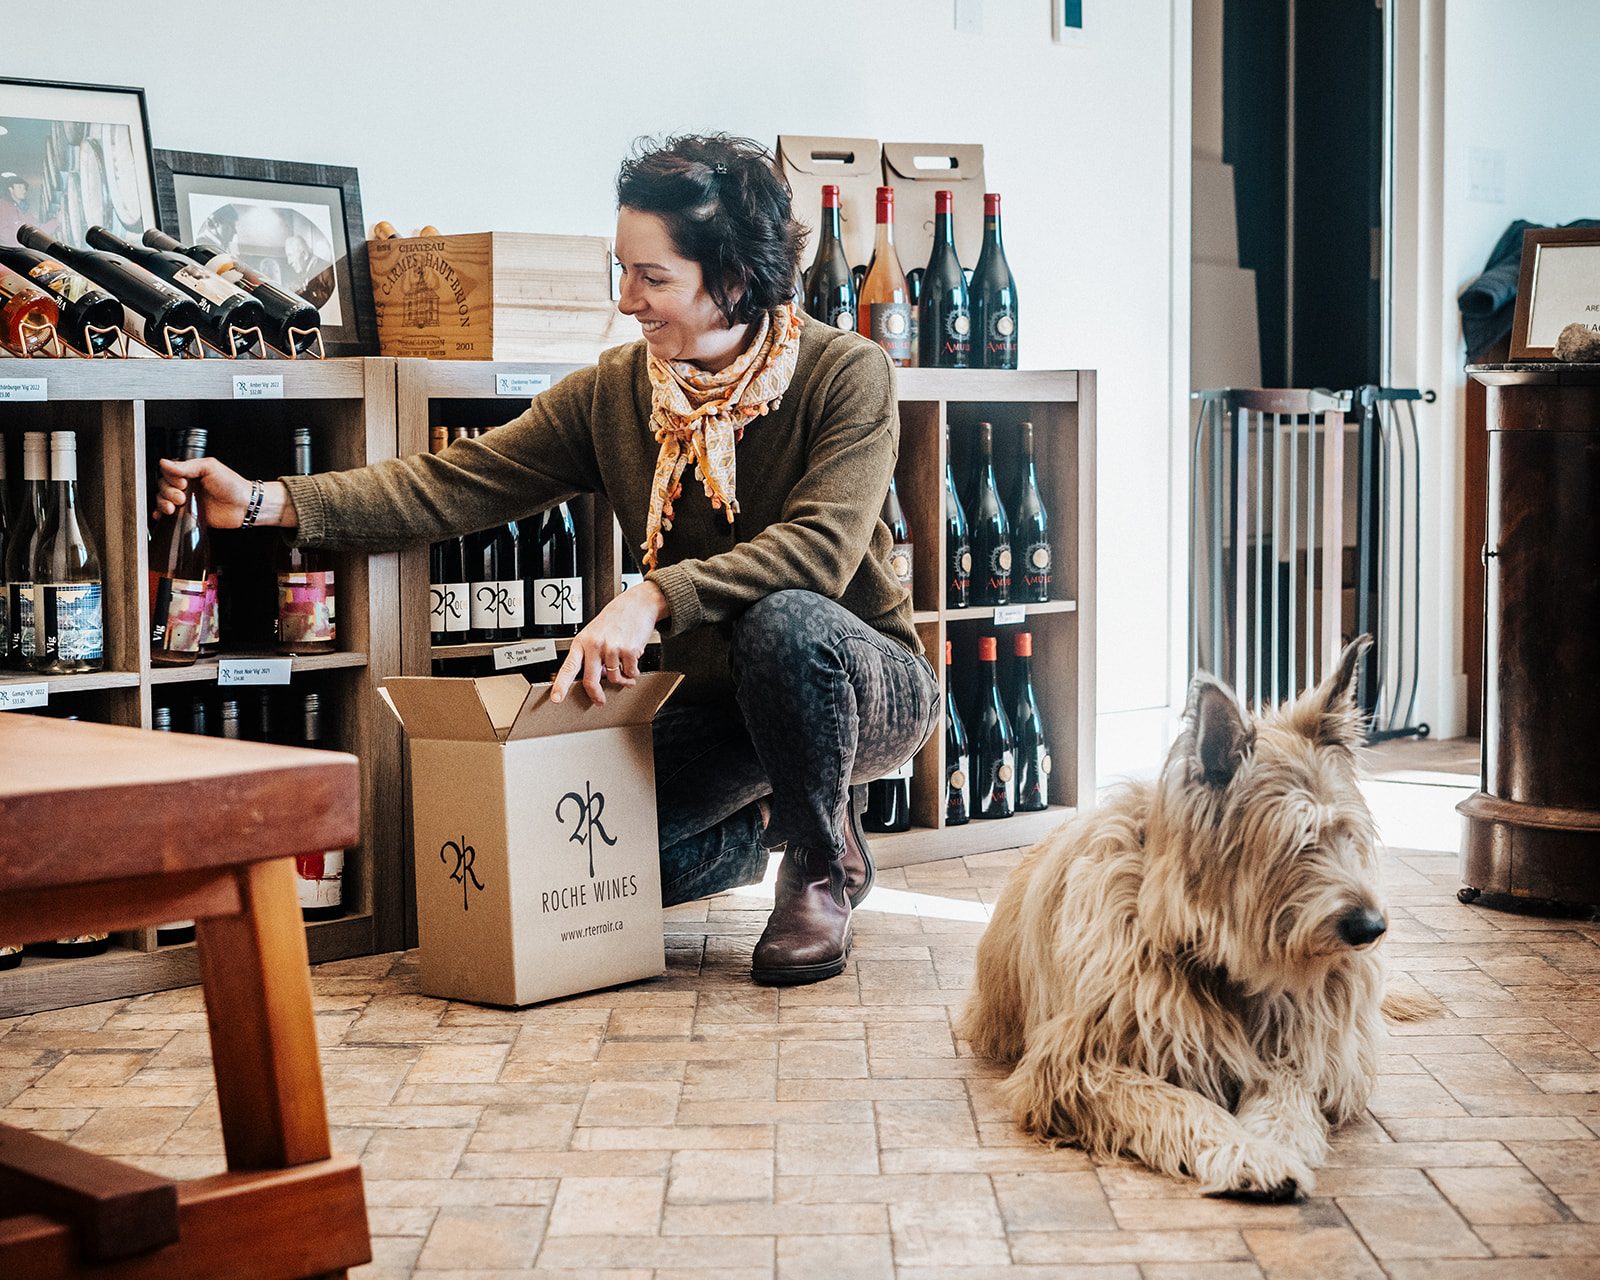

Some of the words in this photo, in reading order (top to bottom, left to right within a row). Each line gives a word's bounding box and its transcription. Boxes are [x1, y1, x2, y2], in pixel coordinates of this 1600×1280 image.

[399, 243, 445, 253] CHATEAU
[381, 253, 418, 296] CARMES
[424, 252, 471, 328] HAUT-BRION
[455, 342, 475, 351] 2001
[152, 625, 166, 642] Vig
[46, 636, 58, 654] Vig
[542, 884, 587, 914] ROCHE
[593, 874, 638, 903] WINES
[561, 920, 624, 942] www.rterroir.ca
